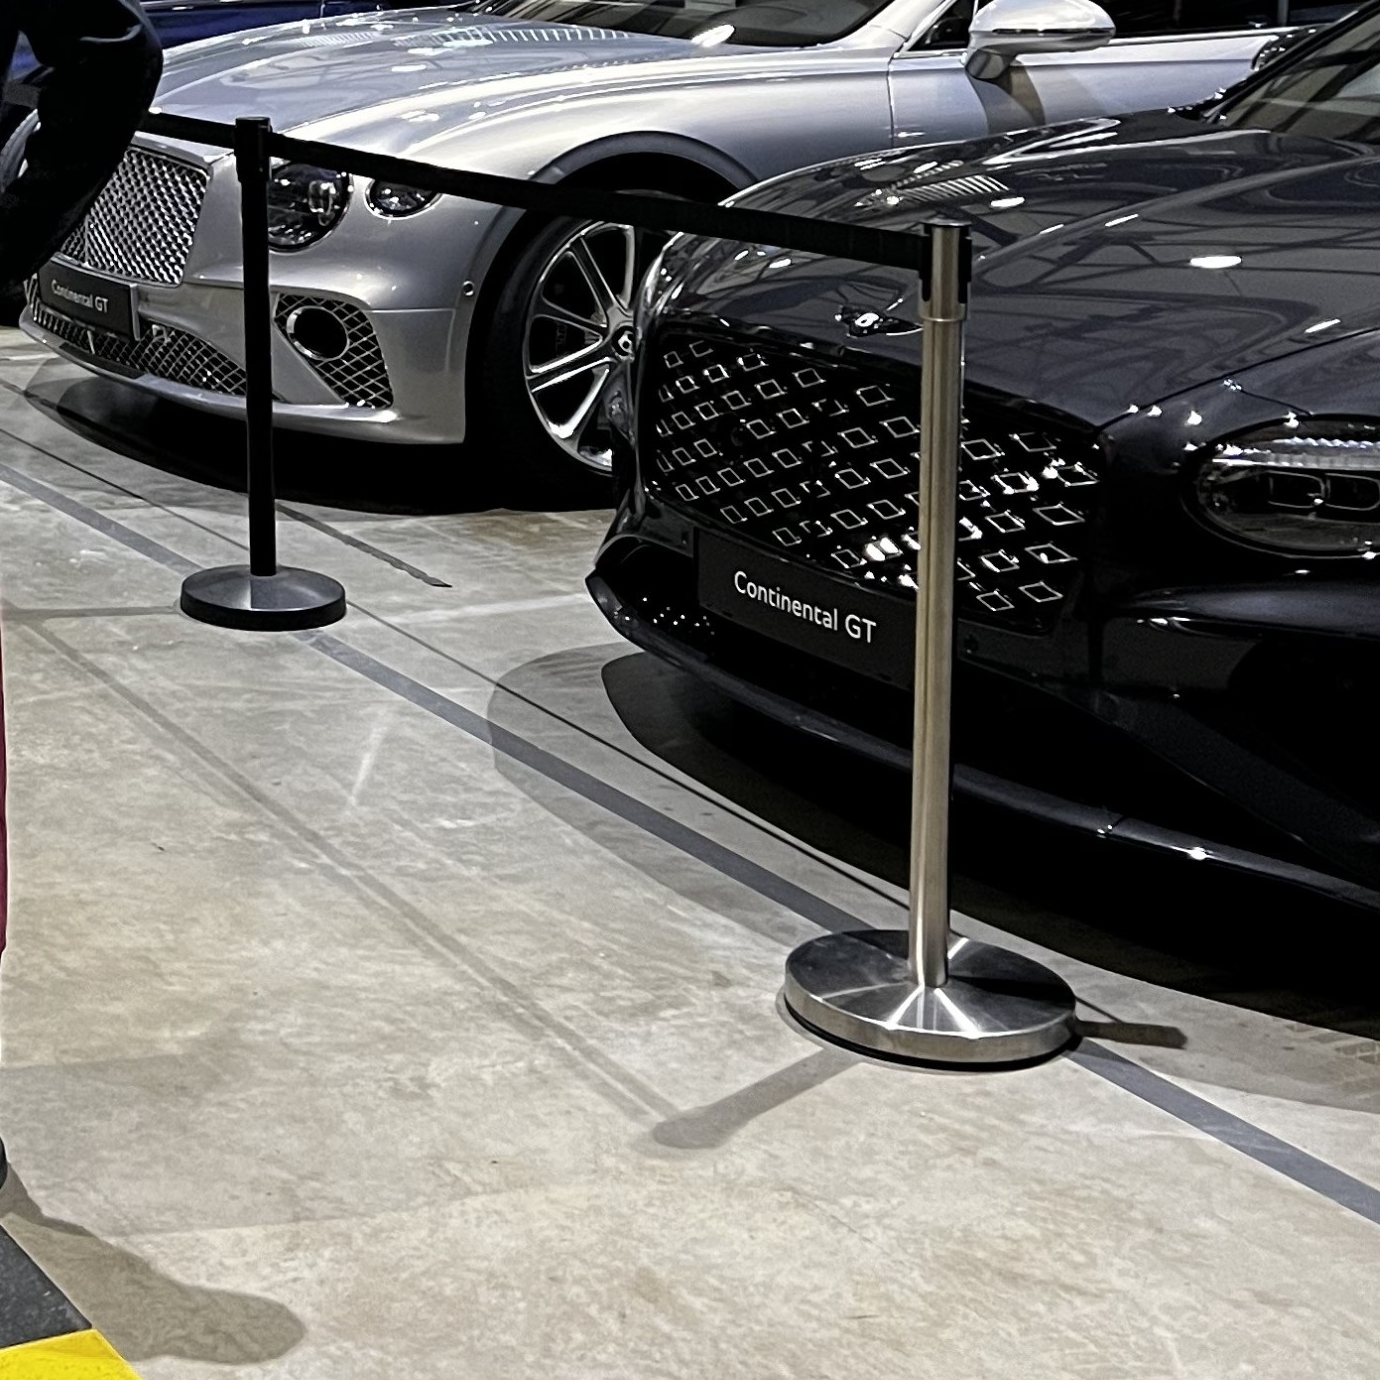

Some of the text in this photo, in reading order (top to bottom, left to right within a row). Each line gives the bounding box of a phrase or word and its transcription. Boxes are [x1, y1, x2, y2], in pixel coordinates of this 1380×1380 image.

[94, 296, 109, 313] GT
[733, 570, 877, 644] Continental GT
